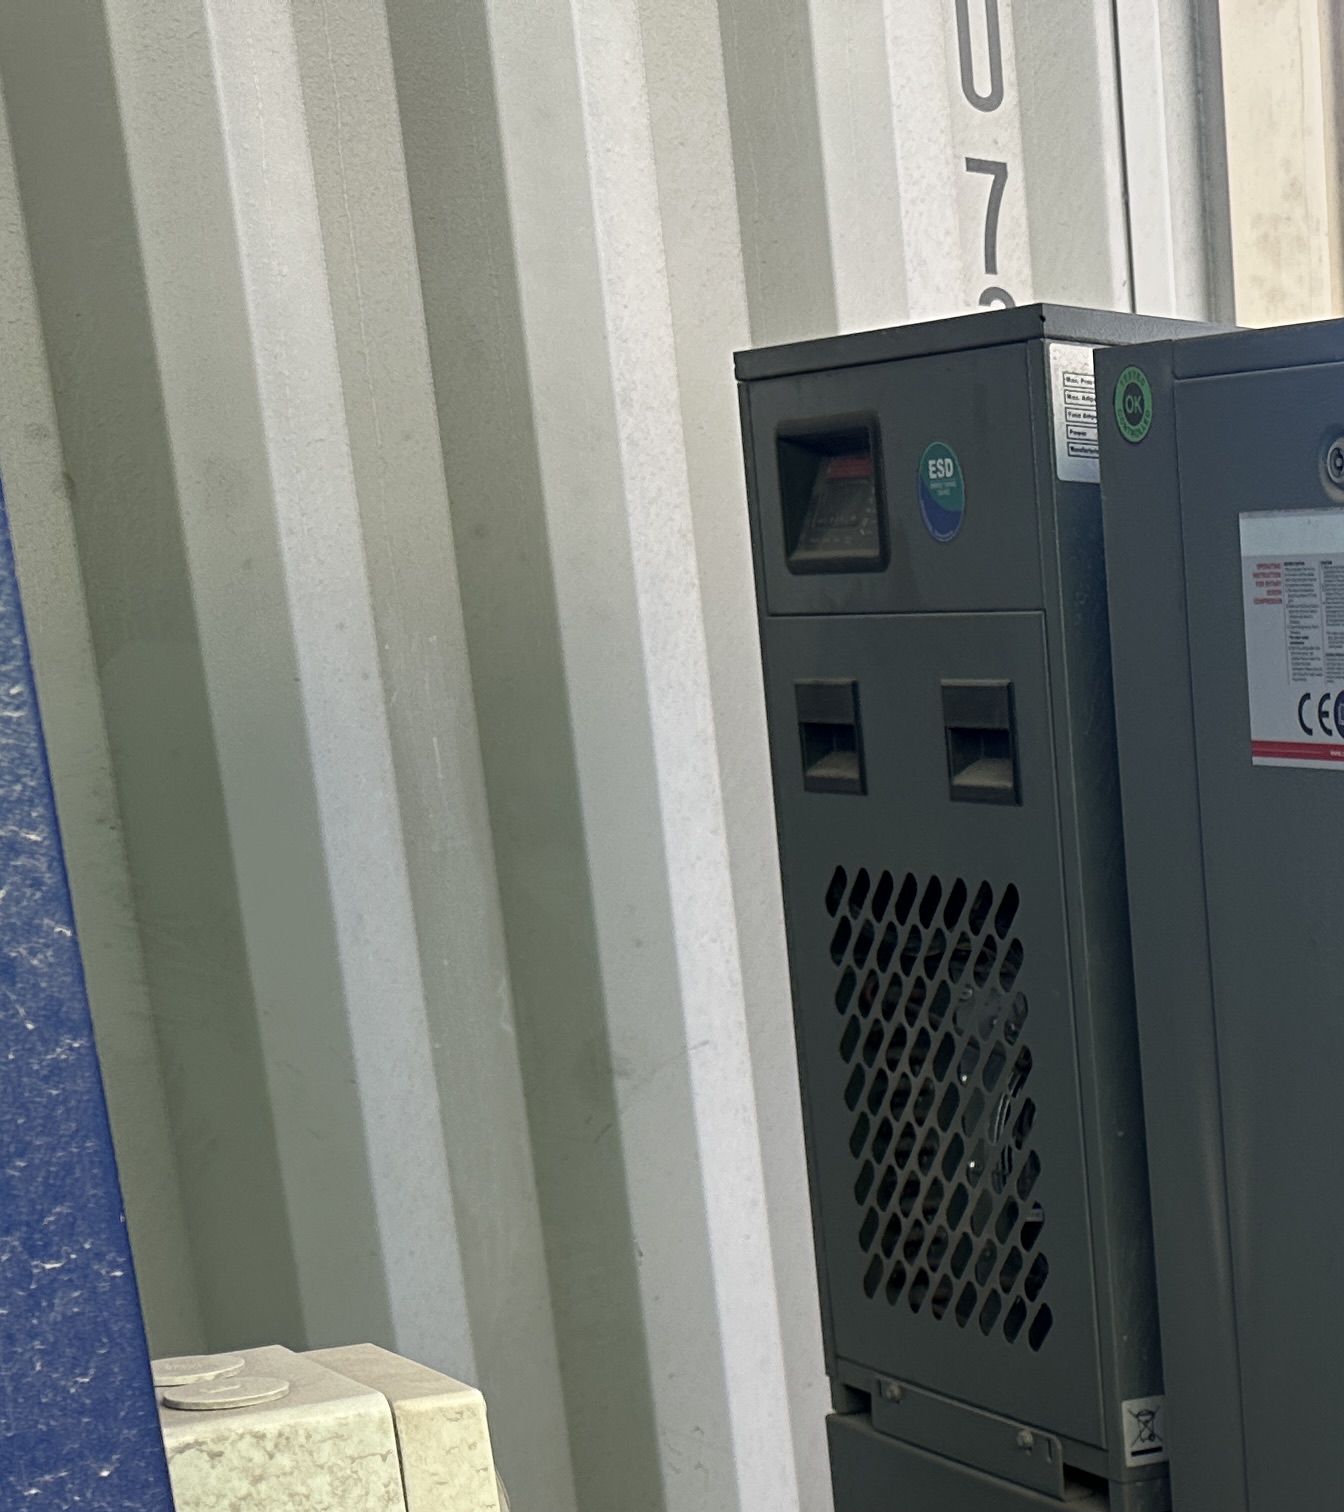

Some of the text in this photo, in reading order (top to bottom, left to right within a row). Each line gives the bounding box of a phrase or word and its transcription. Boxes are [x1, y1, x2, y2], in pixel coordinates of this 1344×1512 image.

[1125, 395, 1142, 414] OK
[928, 458, 954, 479] ESD
[1298, 692, 1333, 736] CE
